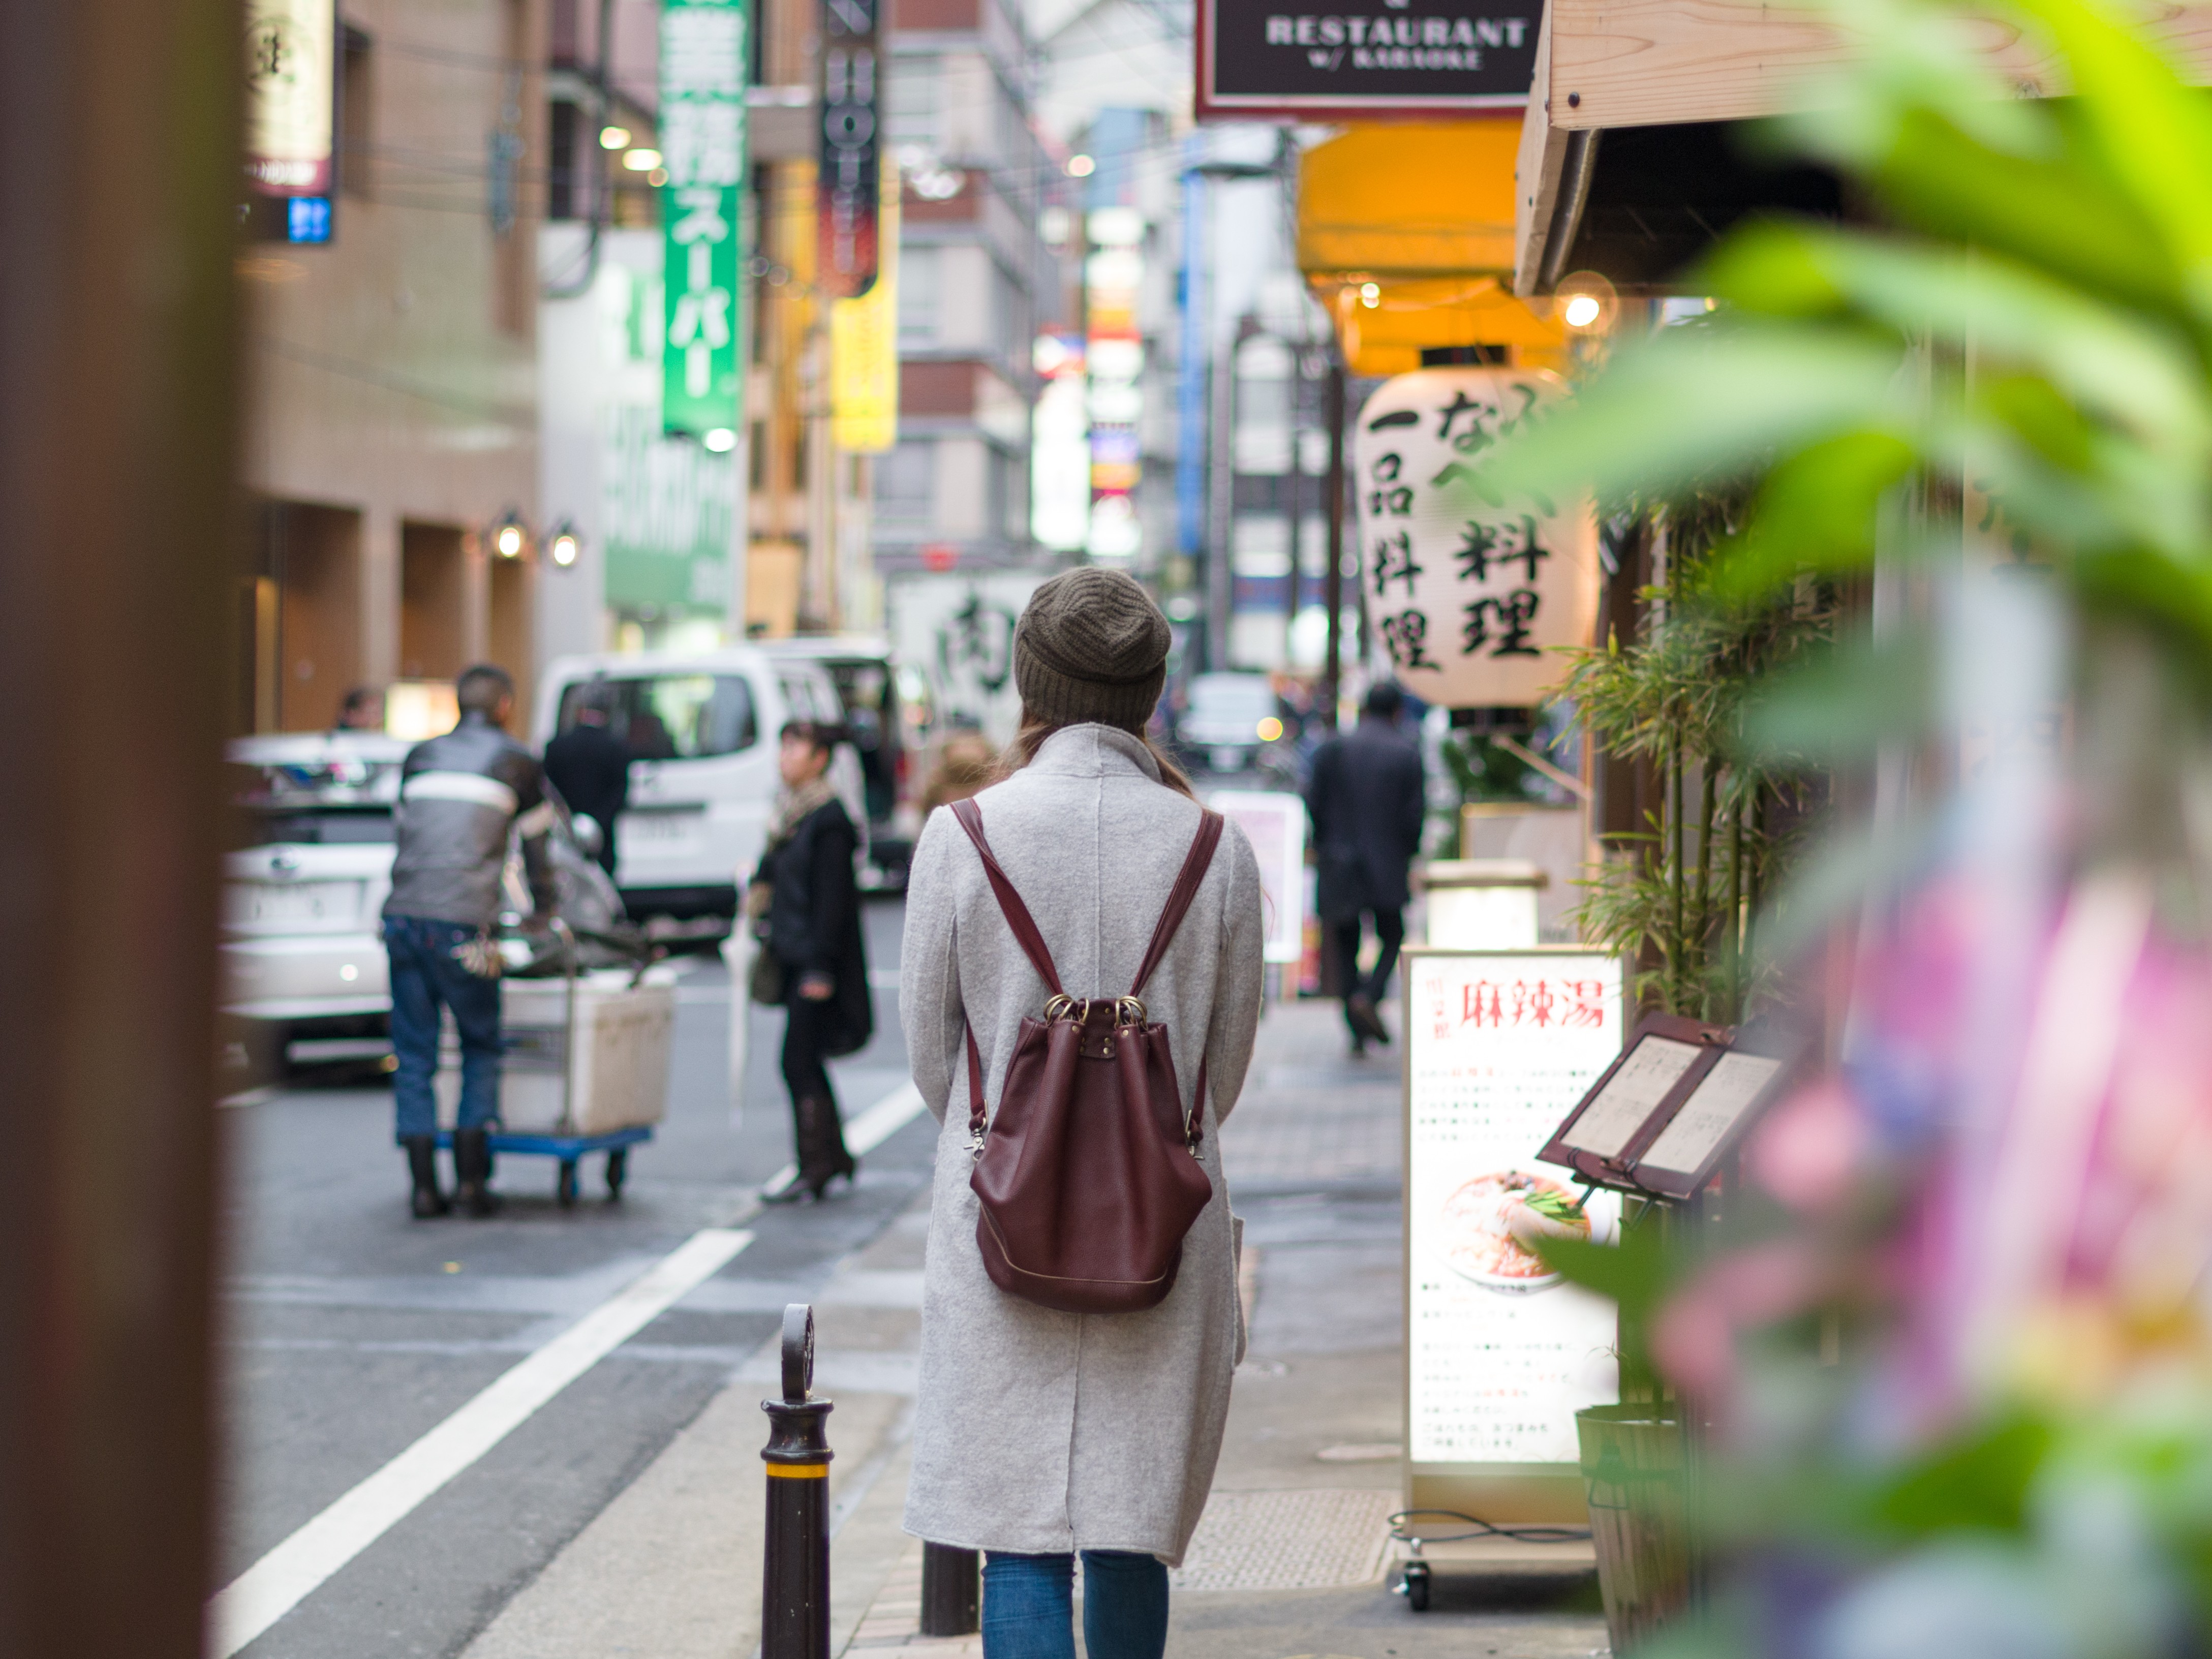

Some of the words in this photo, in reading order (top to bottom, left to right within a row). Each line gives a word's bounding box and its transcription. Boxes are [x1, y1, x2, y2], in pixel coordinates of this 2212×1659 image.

[1265, 15, 1529, 48] RESTAURANT
[1368, 410, 1442, 674] 一品料理
[1460, 979, 1604, 1029] 麻辣湯
